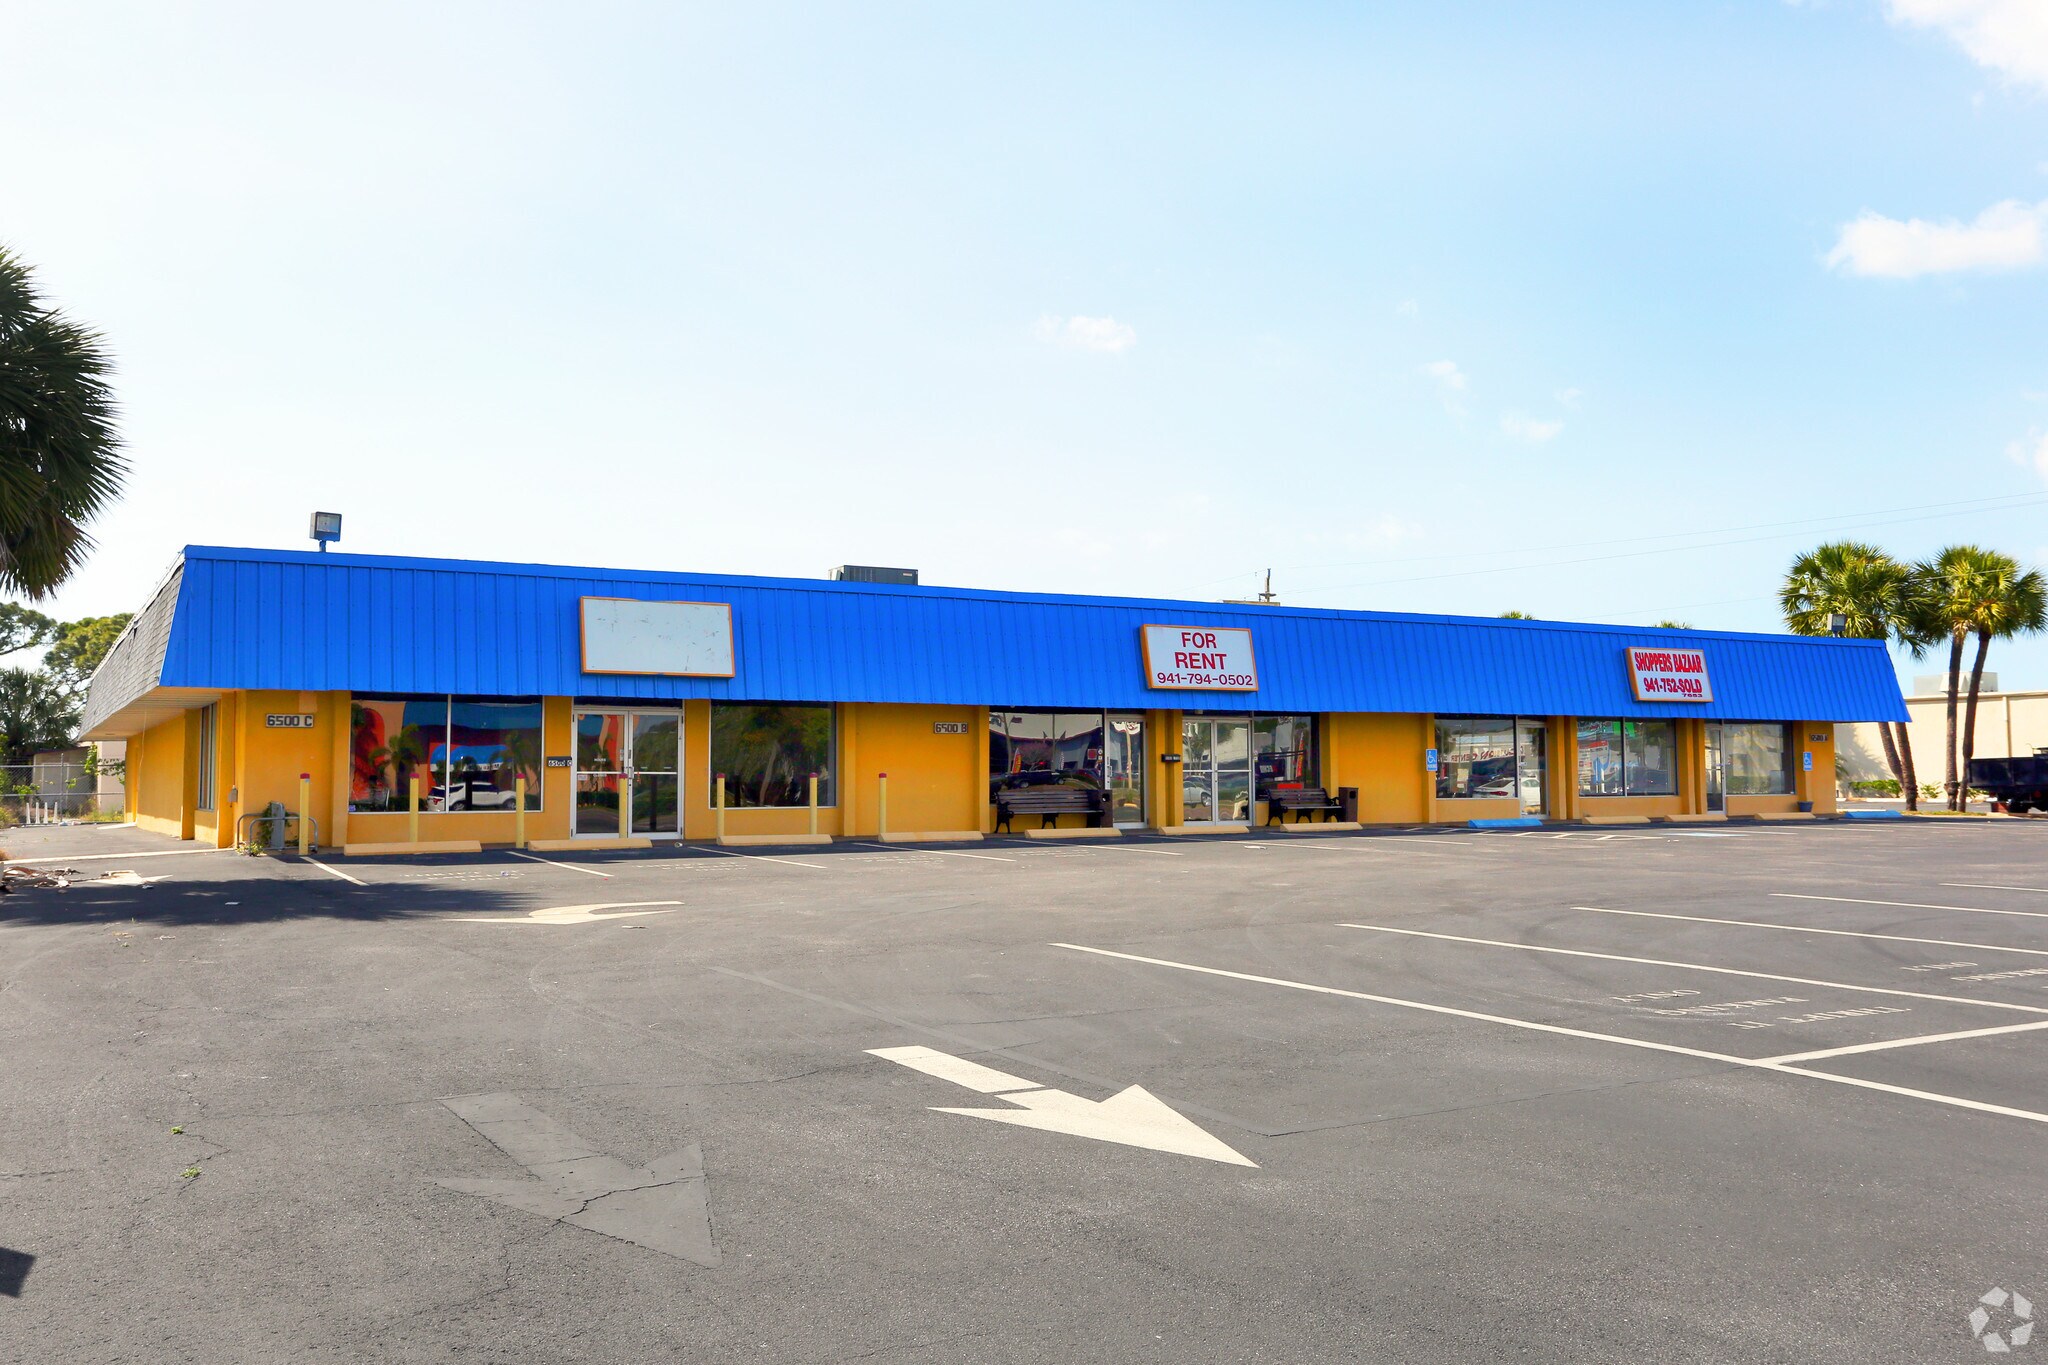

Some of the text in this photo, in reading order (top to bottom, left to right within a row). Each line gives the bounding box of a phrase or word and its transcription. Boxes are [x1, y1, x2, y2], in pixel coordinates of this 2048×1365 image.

[1181, 632, 1217, 648] FOR
[1174, 652, 1227, 670] RENT
[1634, 652, 1703, 673] SHOPPERS BAZAAR
[1157, 672, 1253, 686] 941-794-0502
[267, 715, 312, 726] 6500 C
[936, 723, 958, 732] 6500
[1654, 996, 1810, 1016] PARKING
